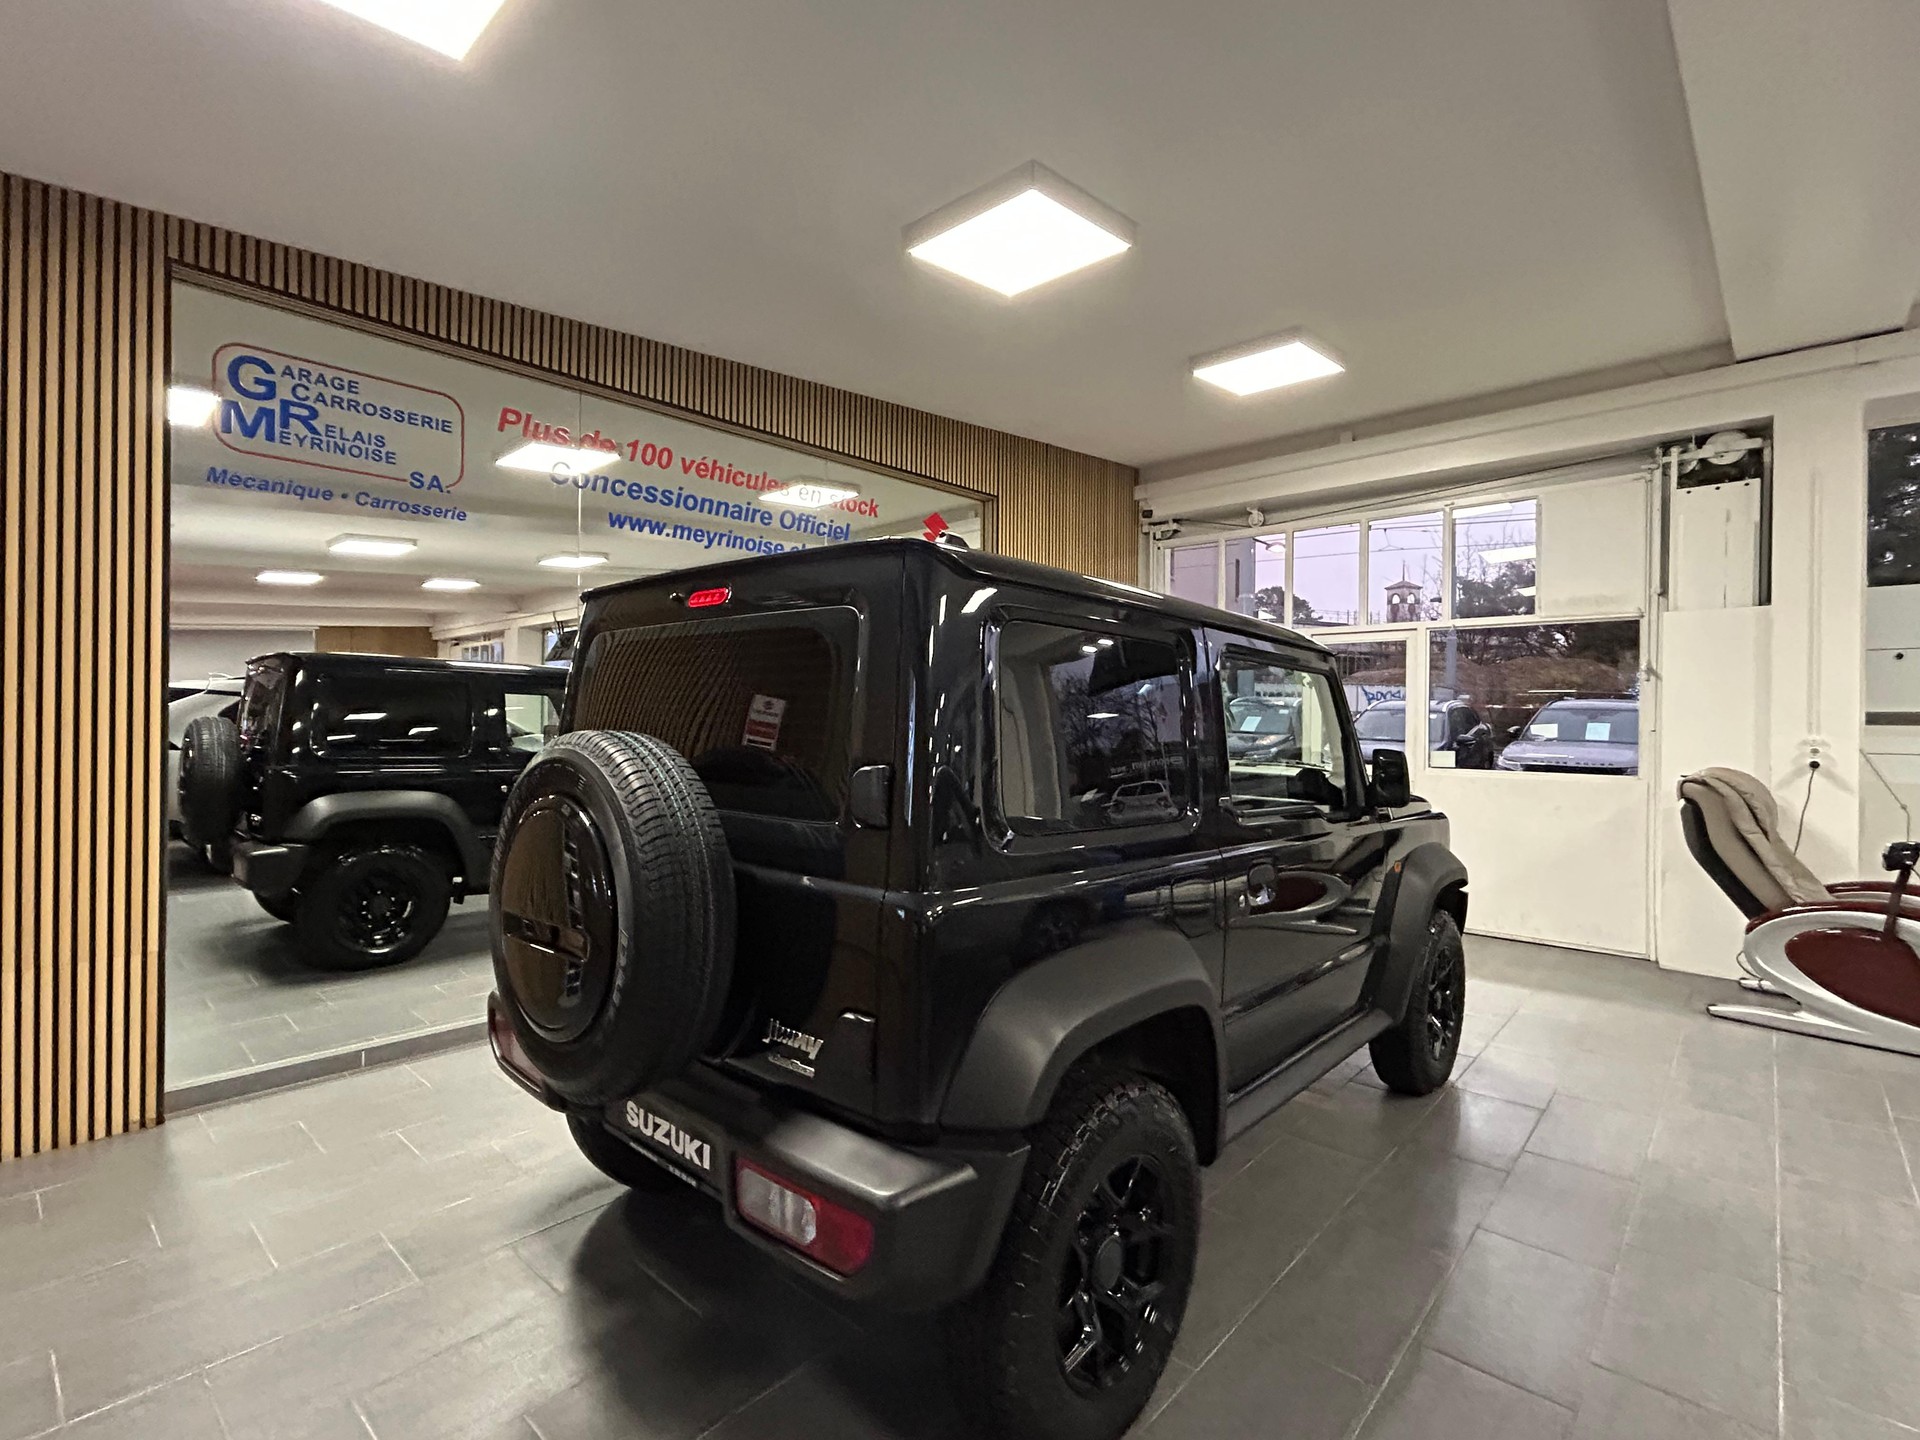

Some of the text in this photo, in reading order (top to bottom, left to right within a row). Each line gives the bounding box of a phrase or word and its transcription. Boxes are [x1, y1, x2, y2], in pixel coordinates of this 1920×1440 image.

[227, 355, 360, 401] GARAGE
[280, 398, 386, 448] RELAIS
[291, 382, 453, 434] CARROSSERIE
[497, 406, 571, 446] Plus
[626, 439, 673, 470] 100
[680, 456, 790, 497] véhicules
[355, 491, 467, 521] Carrosserie
[550, 461, 851, 542] Concessionnaire Officiel
[626, 1100, 711, 1170] SUZUKI
